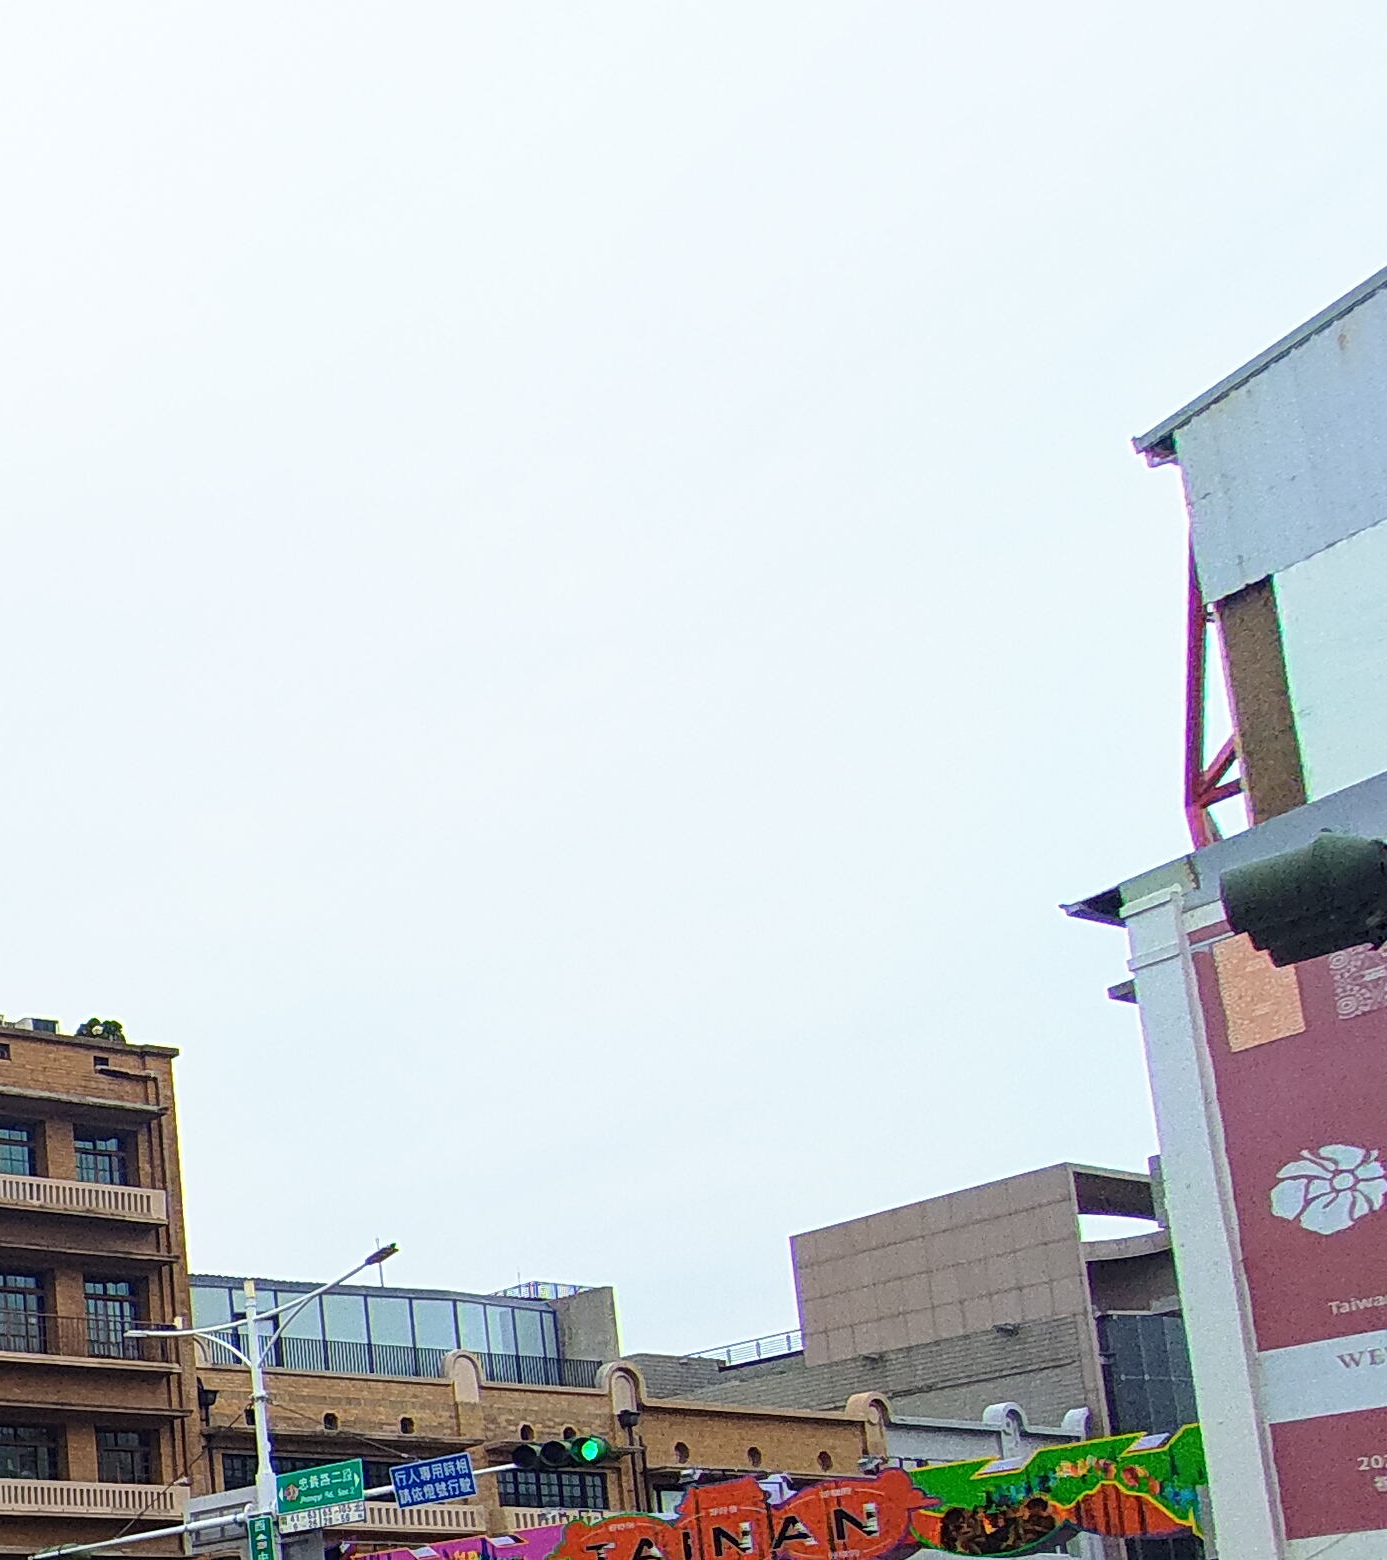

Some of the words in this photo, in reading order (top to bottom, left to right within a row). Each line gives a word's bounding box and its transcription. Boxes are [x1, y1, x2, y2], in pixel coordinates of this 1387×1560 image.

[298, 1468, 353, 1490] 忠義路二段
[394, 1460, 470, 1487] 行人專用時相
